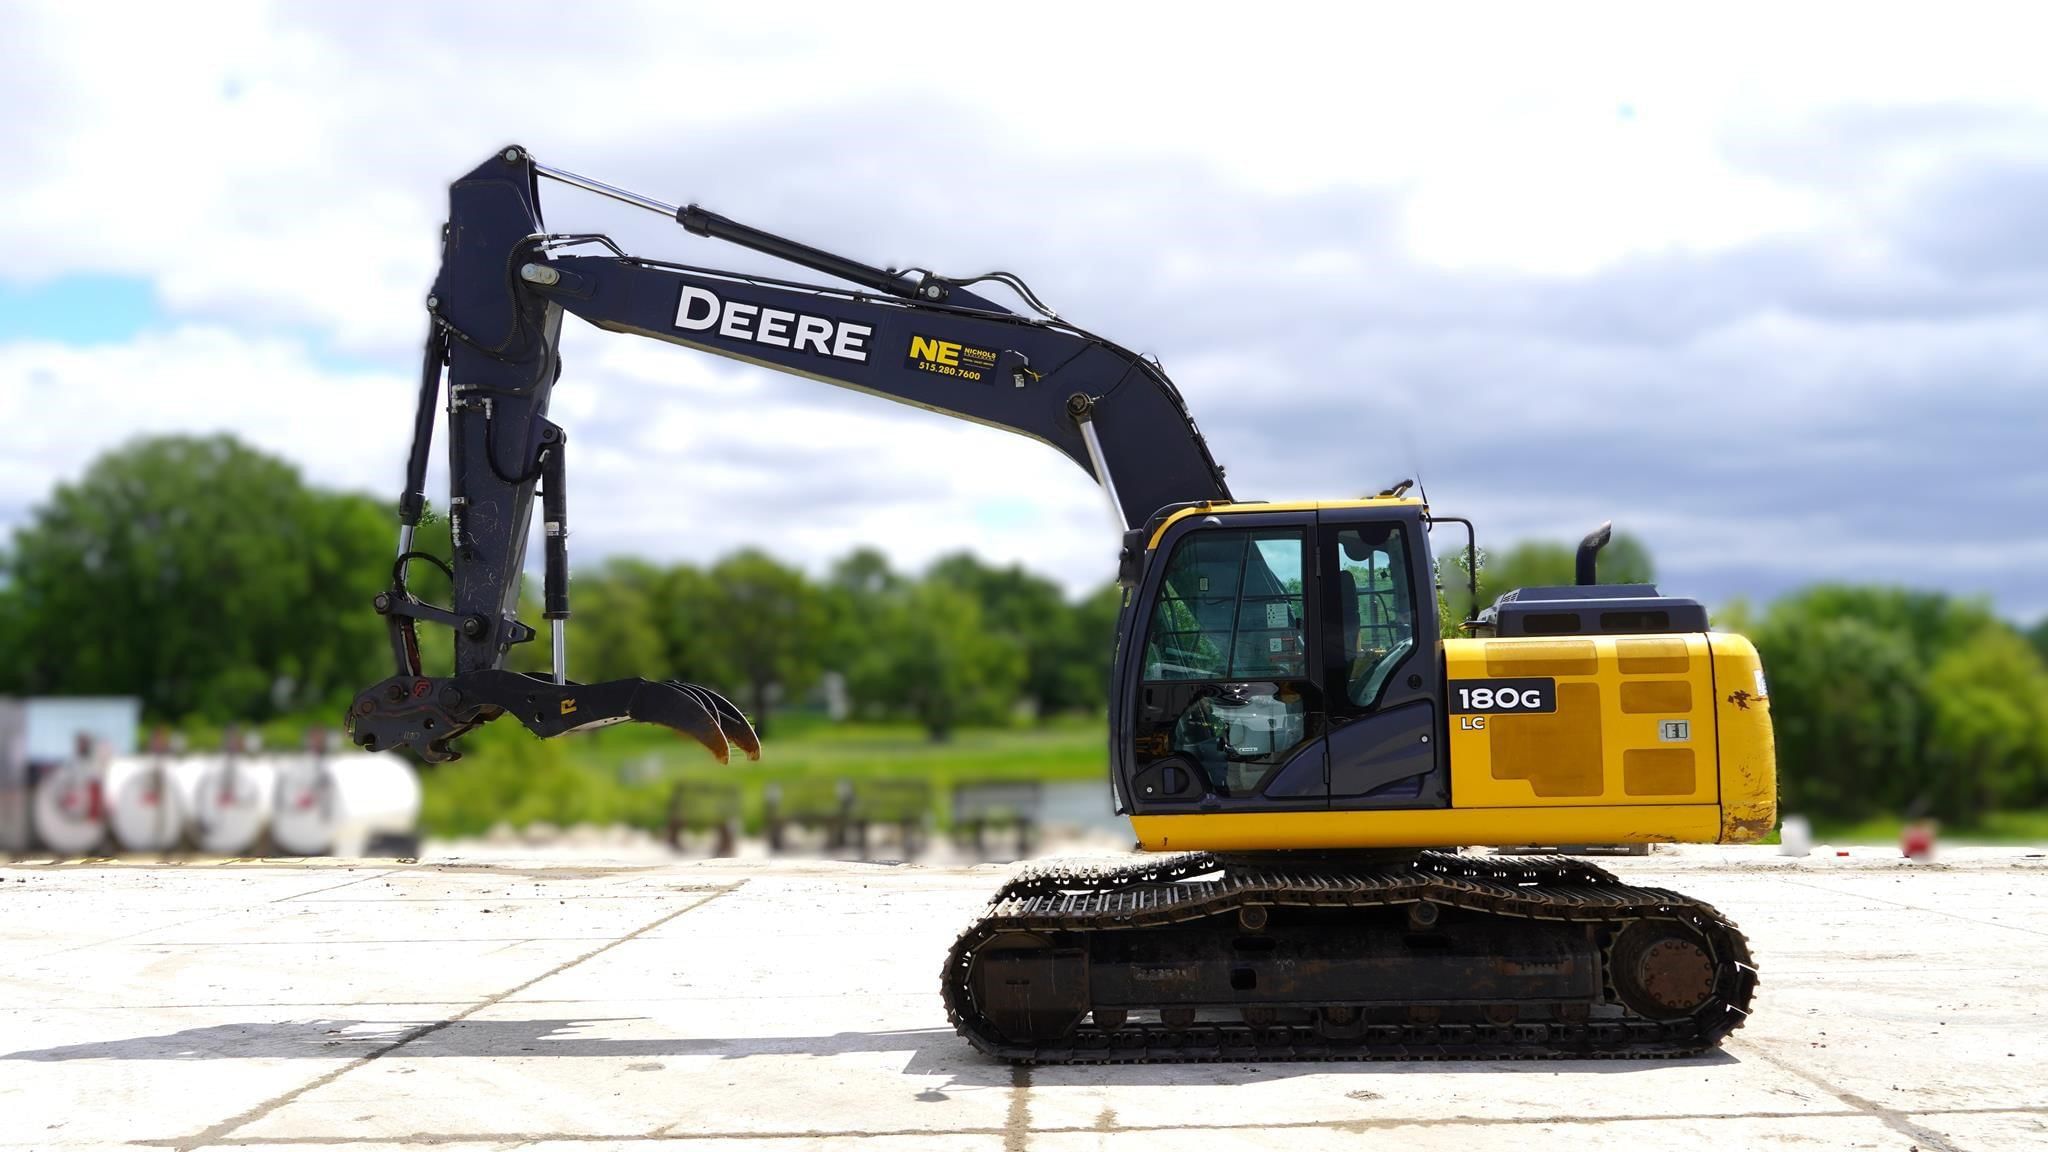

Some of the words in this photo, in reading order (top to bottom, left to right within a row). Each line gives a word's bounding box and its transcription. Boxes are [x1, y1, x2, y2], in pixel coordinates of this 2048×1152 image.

[674, 285, 872, 362] DEERE
[909, 335, 962, 366] NE
[964, 347, 997, 359] NICHOLS
[918, 361, 981, 381] 515.280.7600
[1459, 687, 1541, 709] 180G
[1461, 717, 1485, 730] LC
